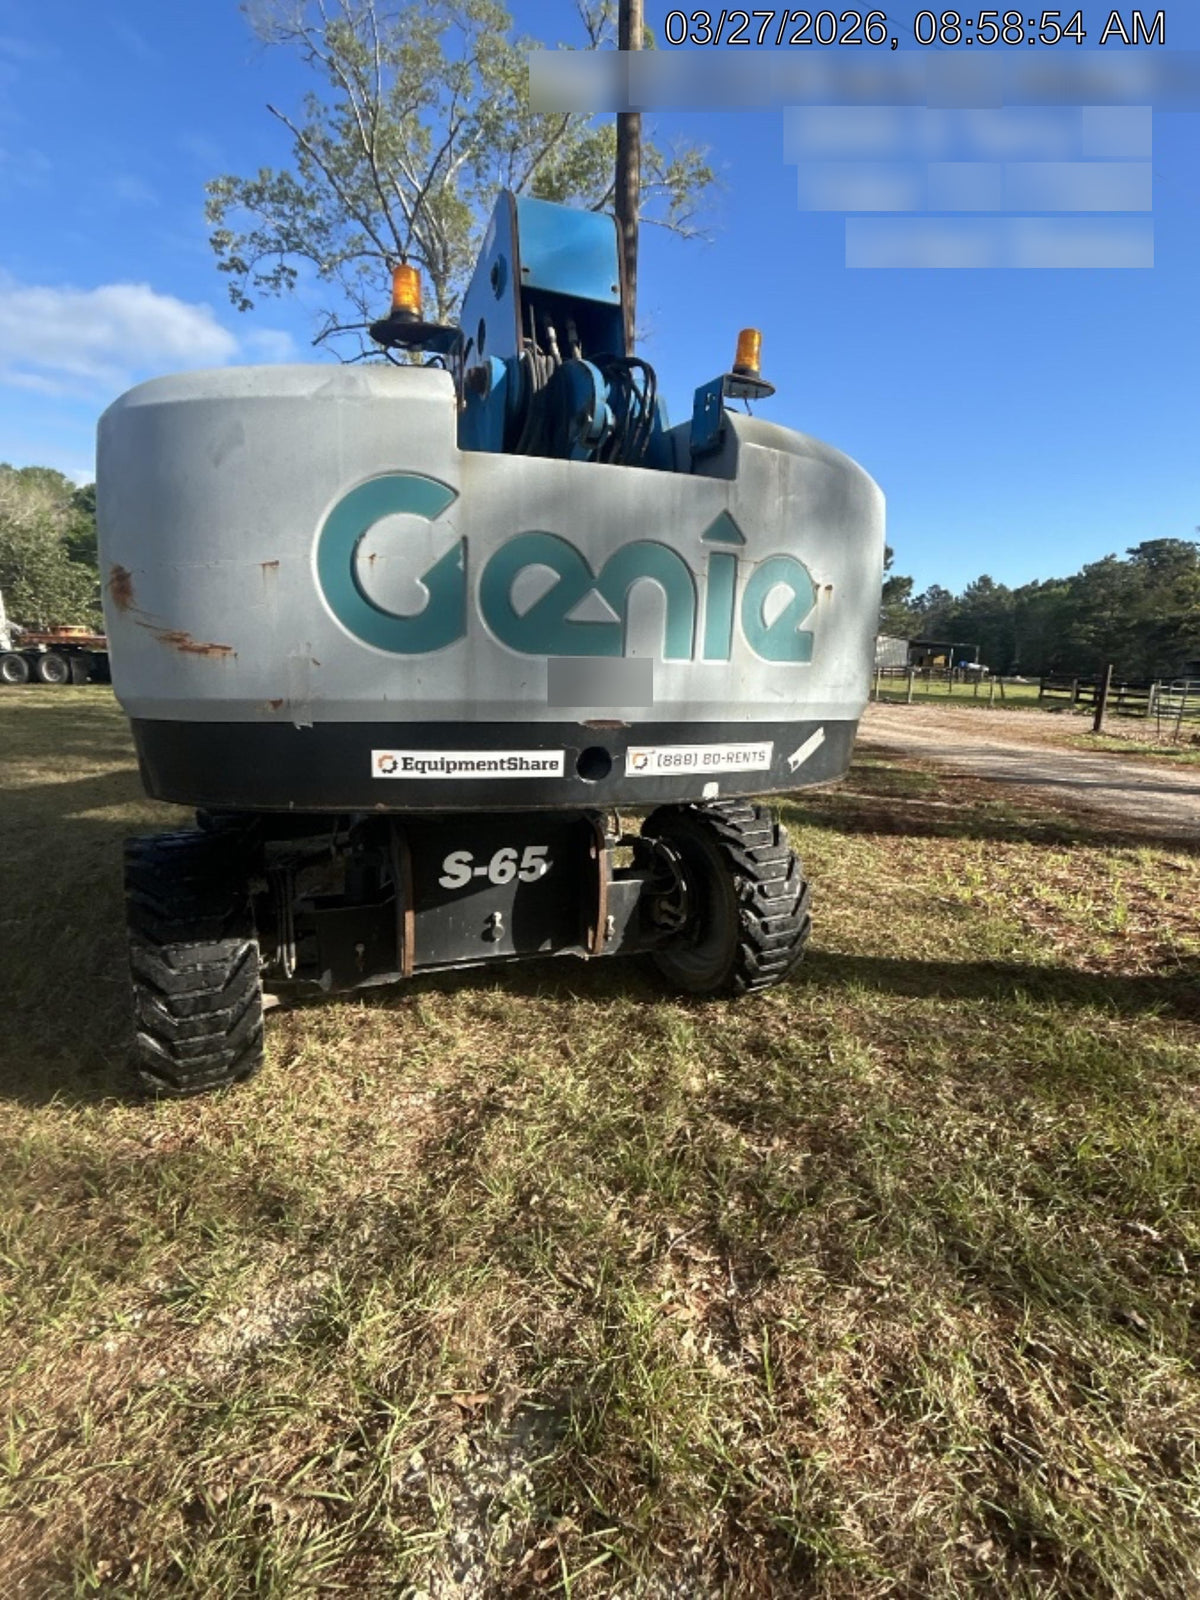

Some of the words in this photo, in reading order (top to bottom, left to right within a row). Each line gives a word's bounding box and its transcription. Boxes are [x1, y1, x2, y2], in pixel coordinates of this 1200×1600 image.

[313, 471, 814, 664] Genie
[401, 757, 559, 774] EquipmentShare
[656, 753, 698, 768] (888)
[438, 845, 549, 889] S-65
